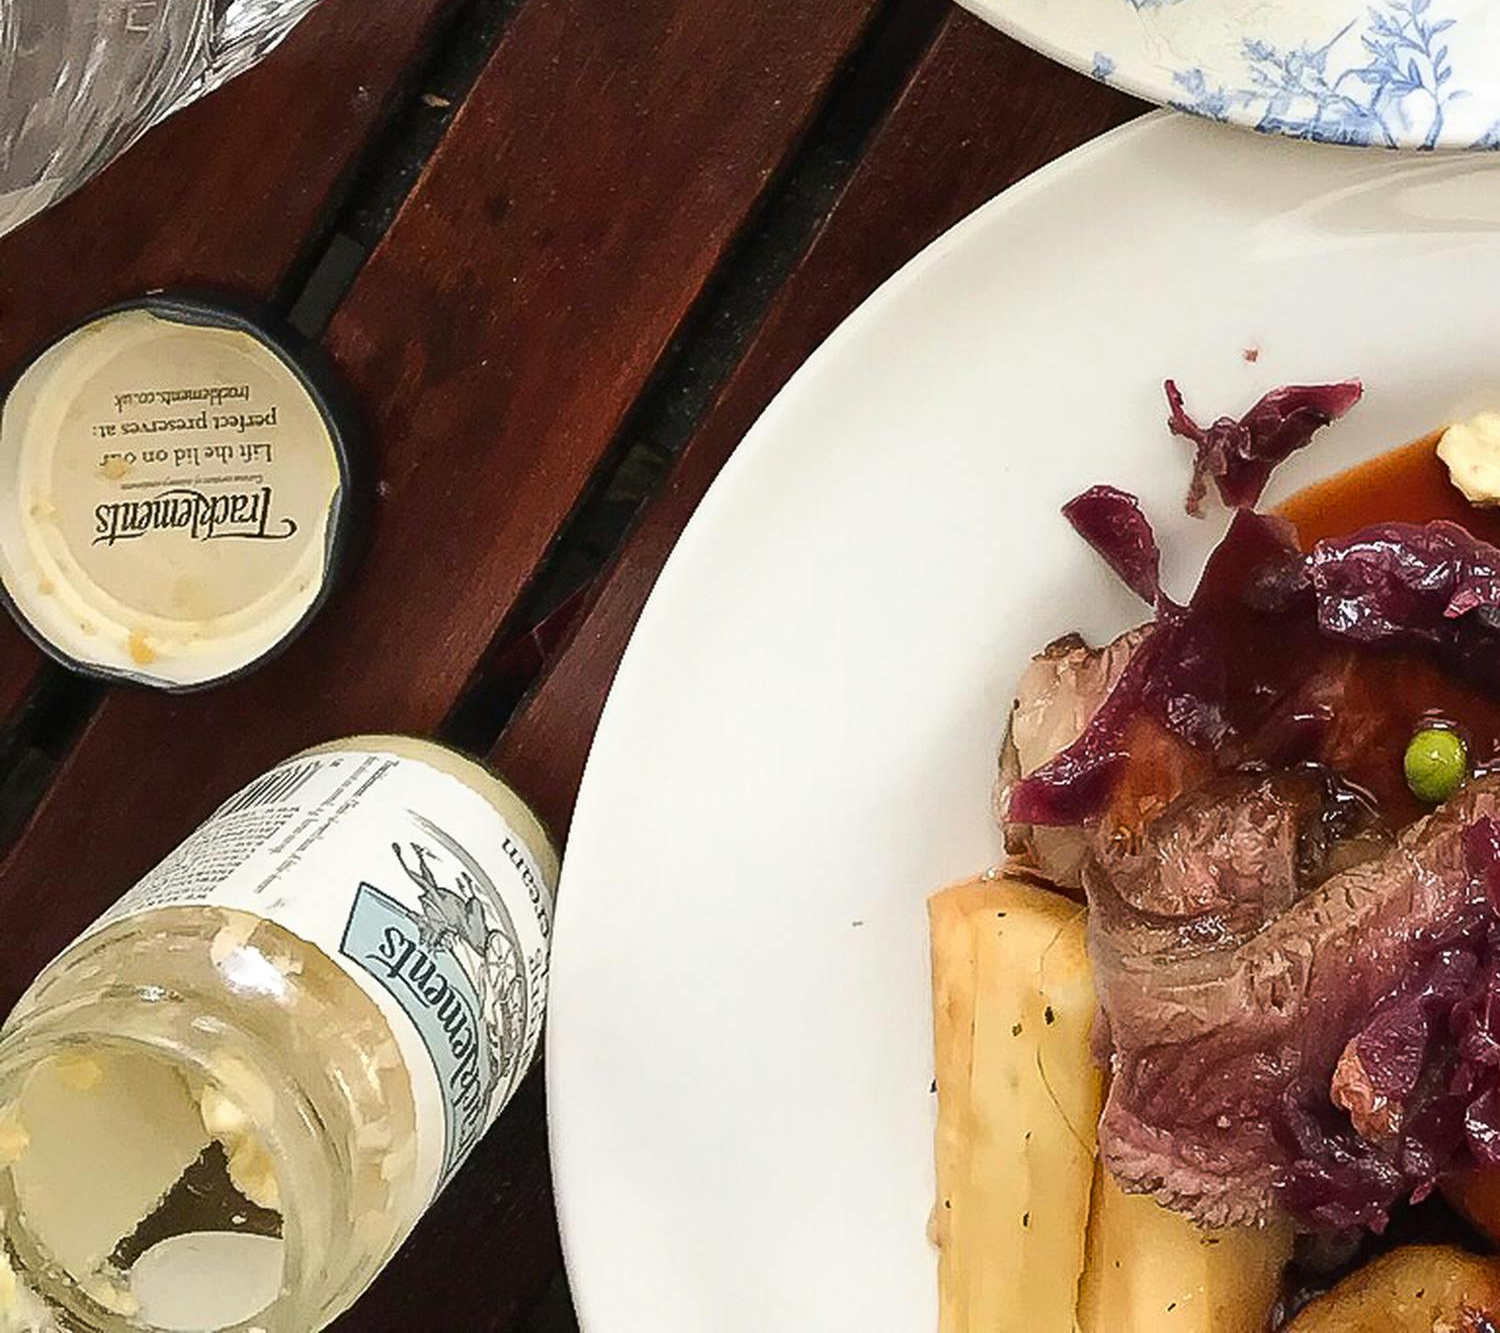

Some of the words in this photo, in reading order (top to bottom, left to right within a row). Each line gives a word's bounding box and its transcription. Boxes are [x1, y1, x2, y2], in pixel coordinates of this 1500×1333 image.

[121, 411, 208, 435] preserves
[214, 407, 278, 433] perfect
[93, 424, 116, 437] at:
[142, 450, 168, 463] on
[174, 448, 200, 466] lid
[204, 445, 234, 464] the
[239, 443, 272, 463] Lift
[91, 487, 297, 546] Tracklements
[501, 837, 550, 938] cream
